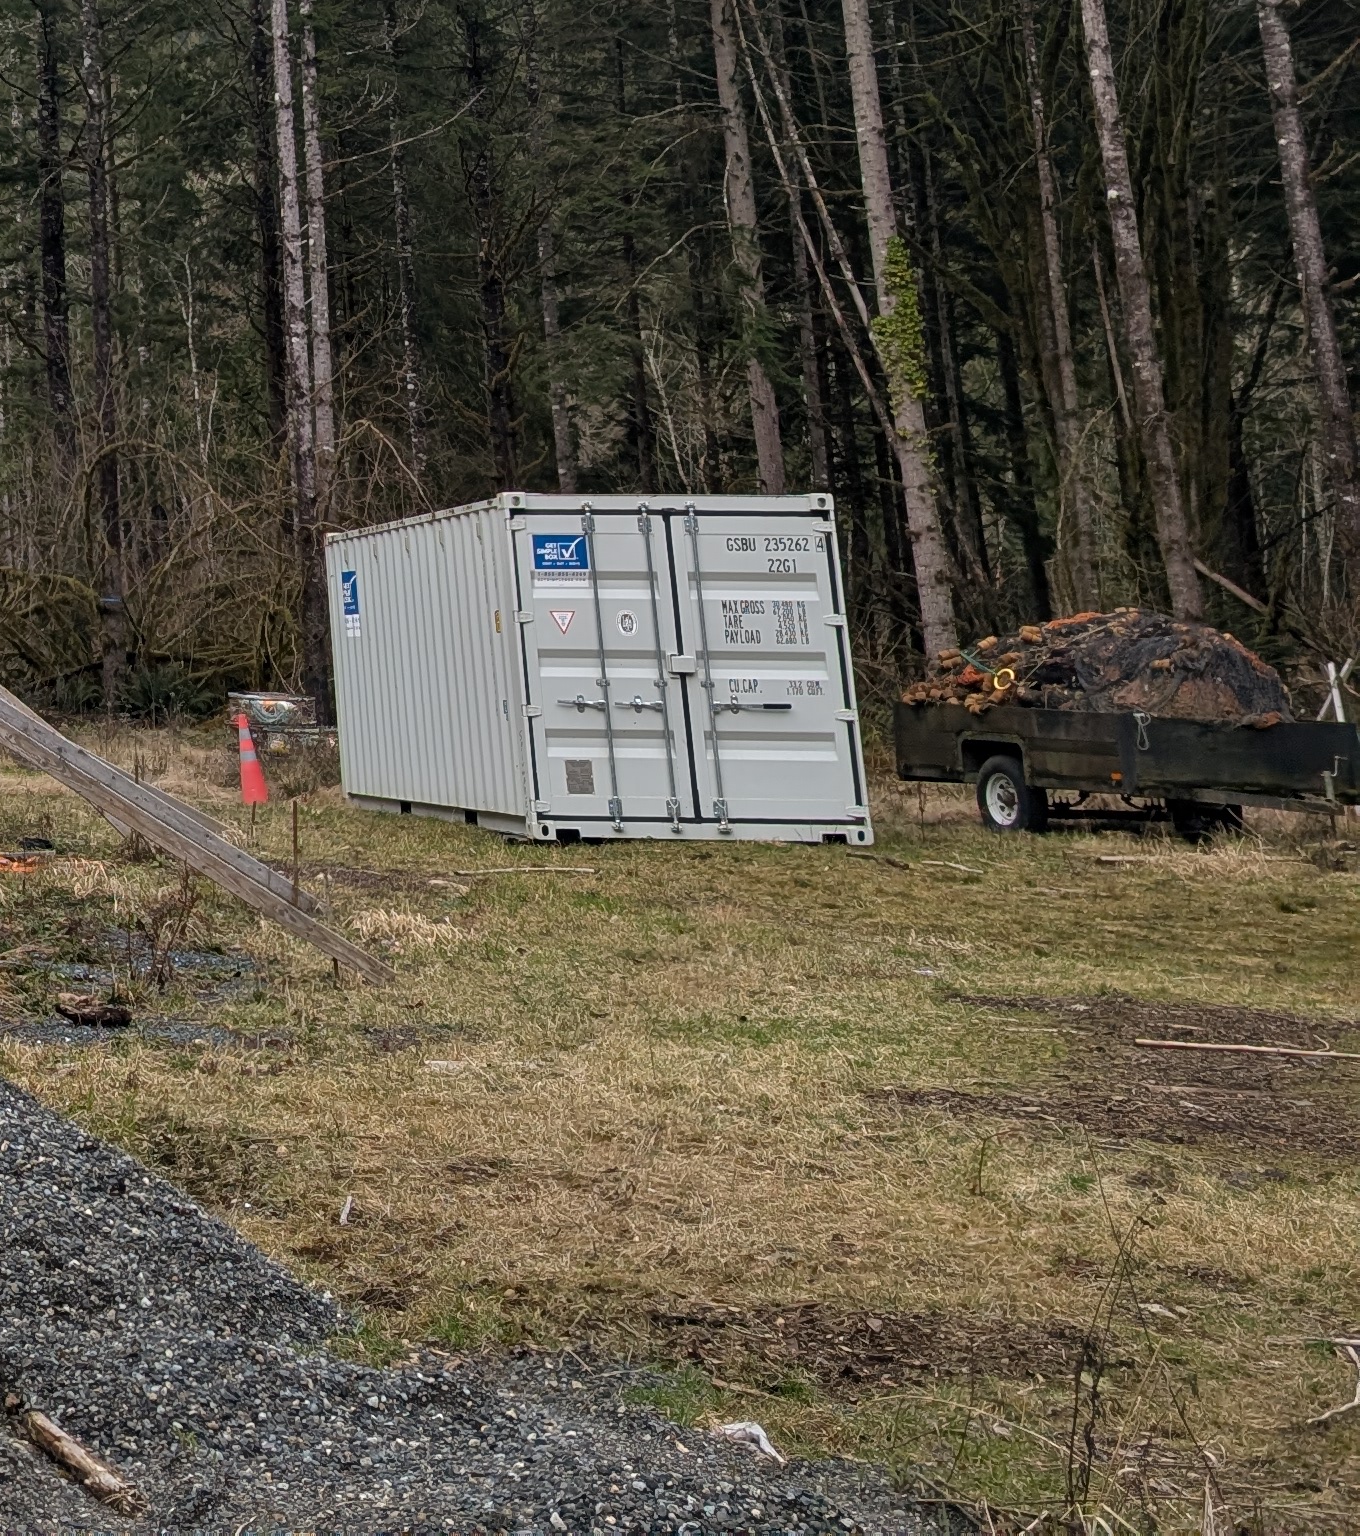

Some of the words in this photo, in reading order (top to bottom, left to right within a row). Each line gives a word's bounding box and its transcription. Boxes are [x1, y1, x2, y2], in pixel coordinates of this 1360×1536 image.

[726, 537, 757, 552] GSBU
[763, 537, 810, 552] 235262
[767, 558, 797, 574] 22G1
[723, 615, 744, 629] TARE
[724, 630, 761, 644] PAYLOAD
[728, 678, 763, 694] CU.CAP.
